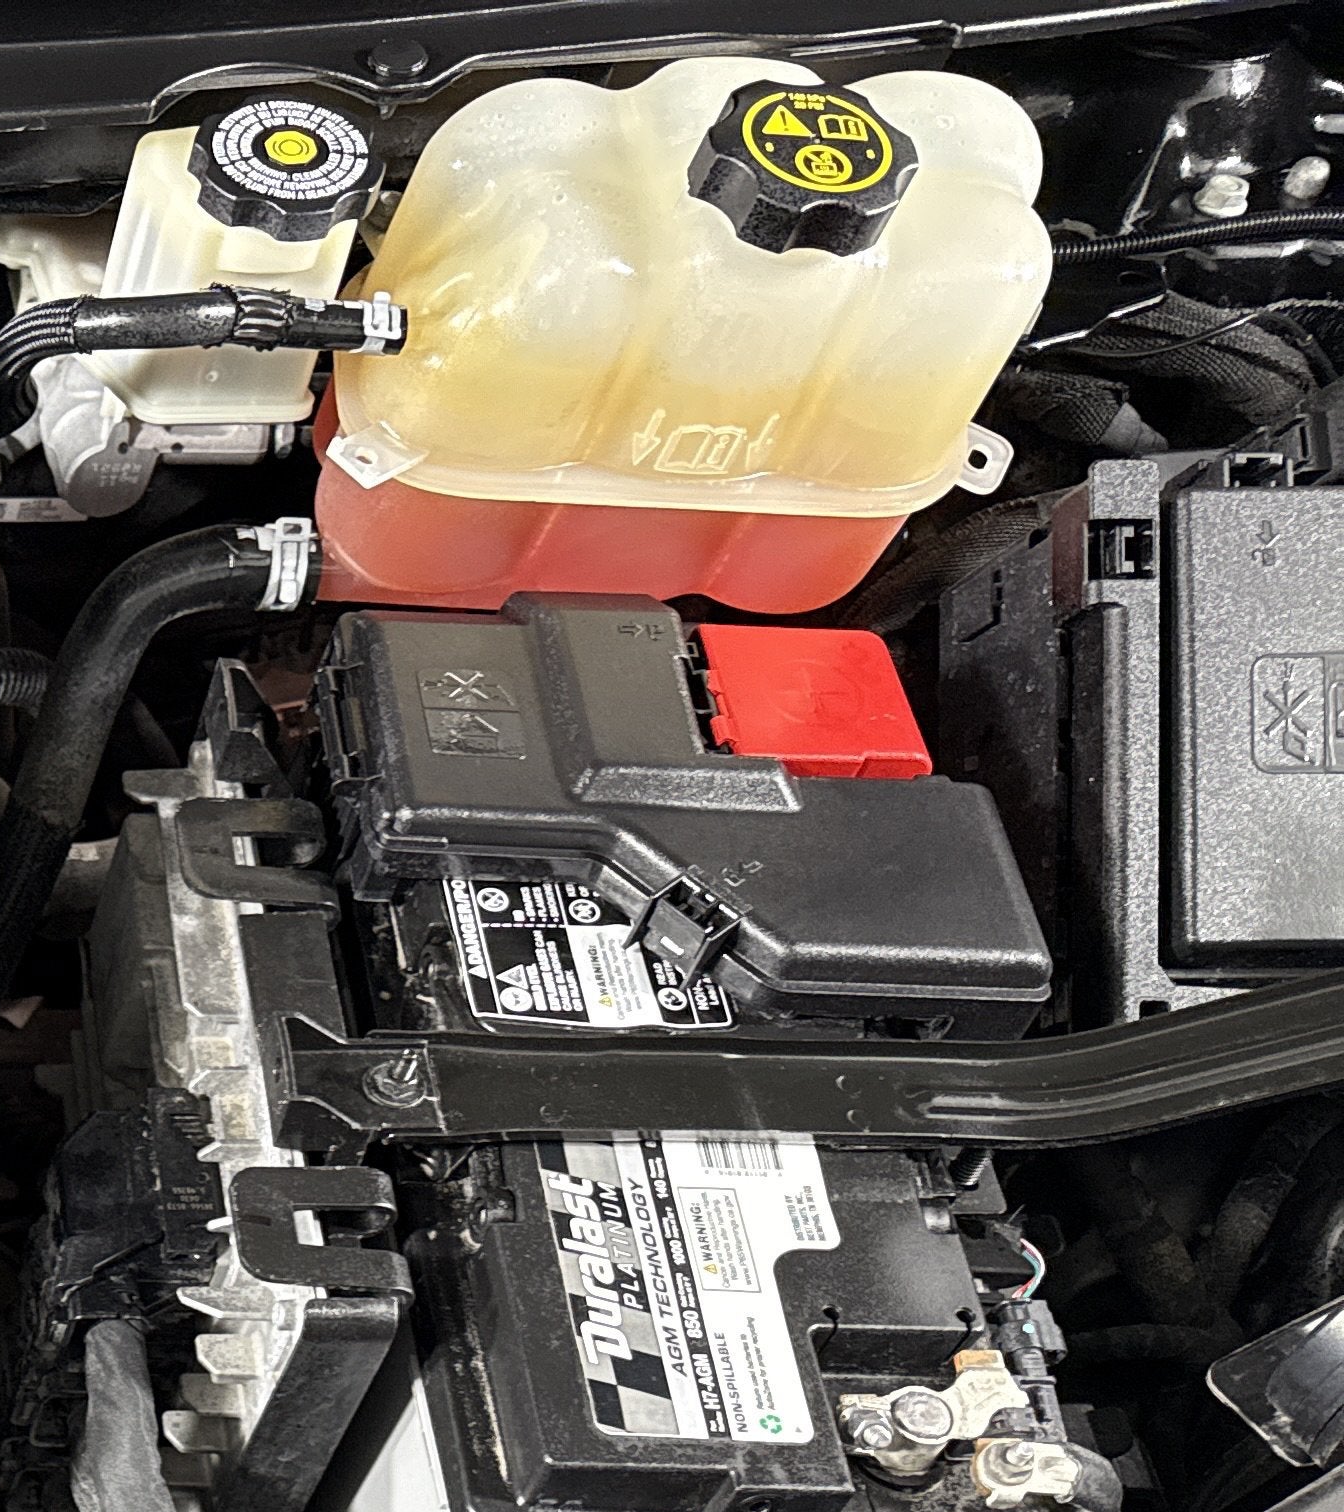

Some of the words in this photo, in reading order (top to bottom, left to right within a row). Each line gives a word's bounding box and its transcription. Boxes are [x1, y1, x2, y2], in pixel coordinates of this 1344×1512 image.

[547, 1172, 633, 1365] Duralast
[597, 1181, 644, 1310] PLATINUM
[627, 1177, 673, 1318] TECHNOLOGY
[662, 1326, 687, 1377] AGM
[714, 1332, 748, 1432] NON-SPILLABLE
